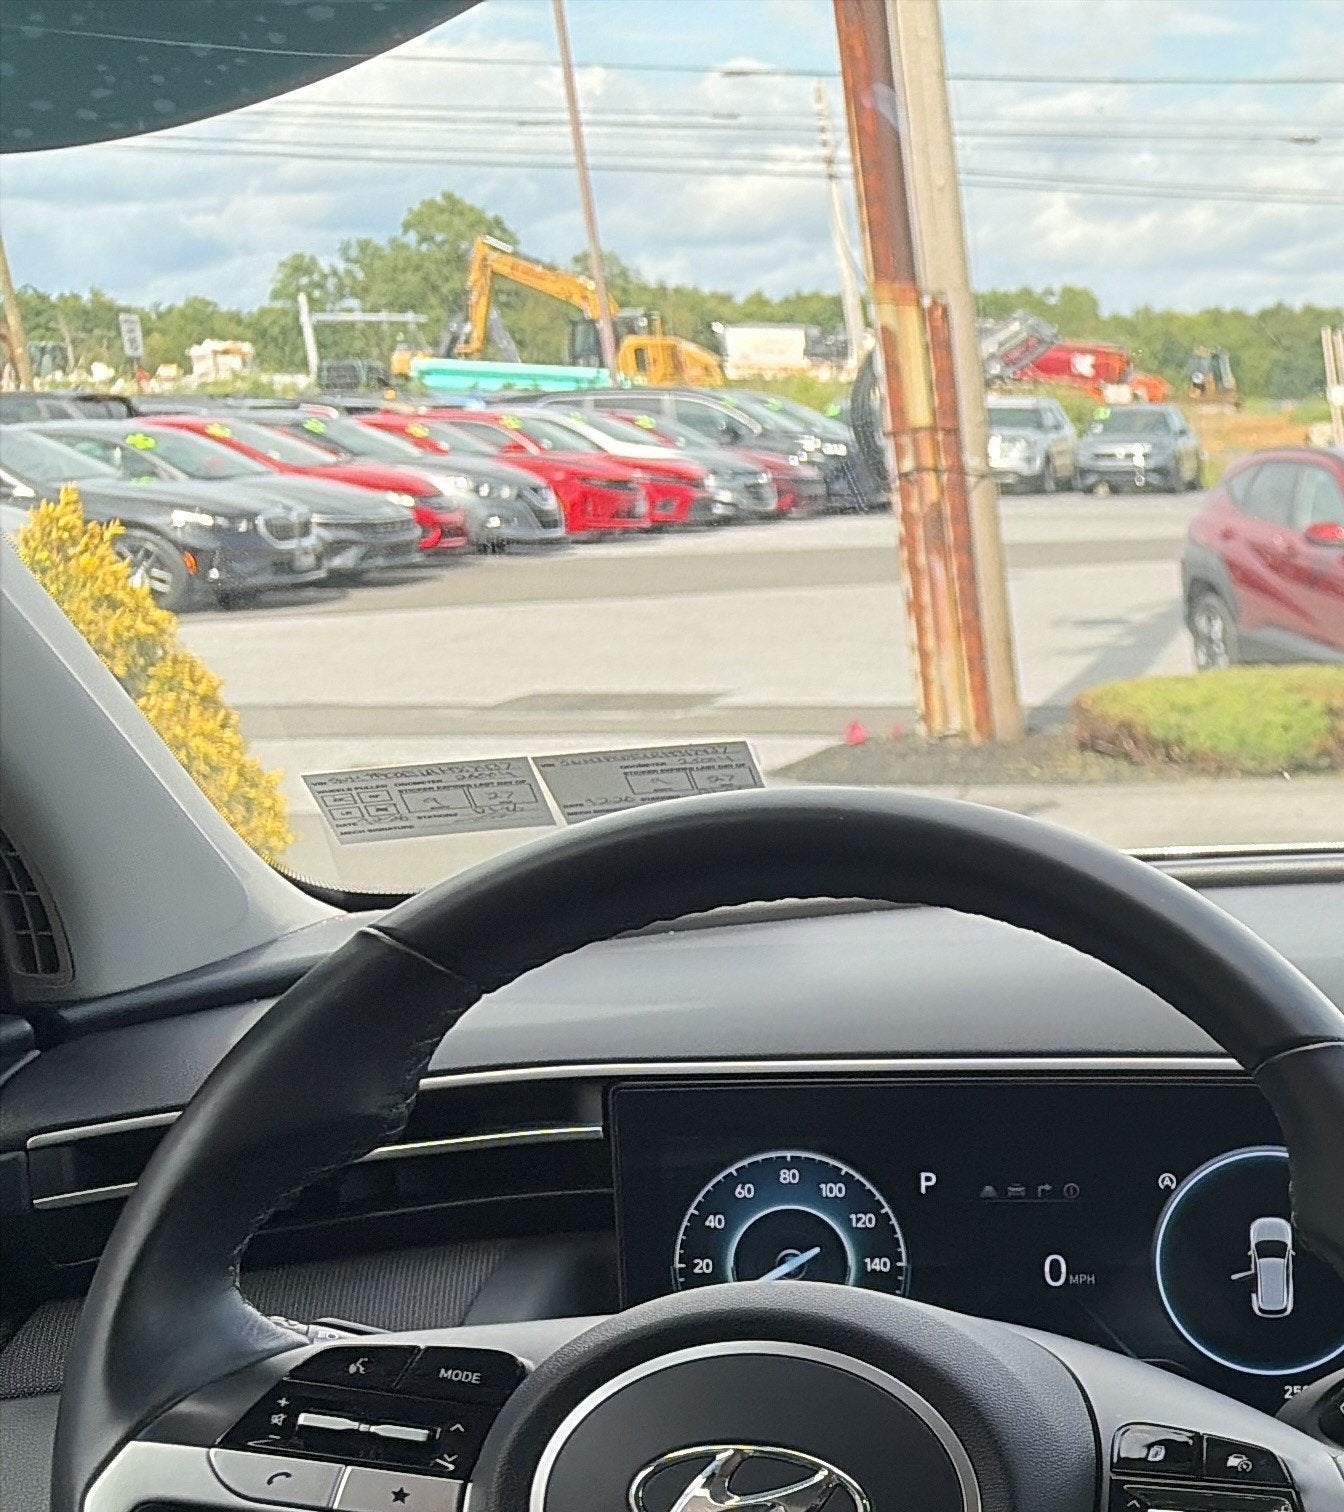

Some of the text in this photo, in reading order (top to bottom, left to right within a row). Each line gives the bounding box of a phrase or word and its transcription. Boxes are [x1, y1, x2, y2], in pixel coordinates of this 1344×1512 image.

[779, 1169, 800, 1184] 80
[919, 1172, 937, 1194] P
[734, 1183, 755, 1199] 60
[819, 1182, 846, 1198] 100
[705, 1214, 725, 1229] 40
[849, 1213, 876, 1228] 120
[693, 1259, 713, 1274] 20
[864, 1257, 891, 1272] 140
[1044, 1254, 1096, 1287] 0 MPH
[438, 1367, 482, 1385] MODE
